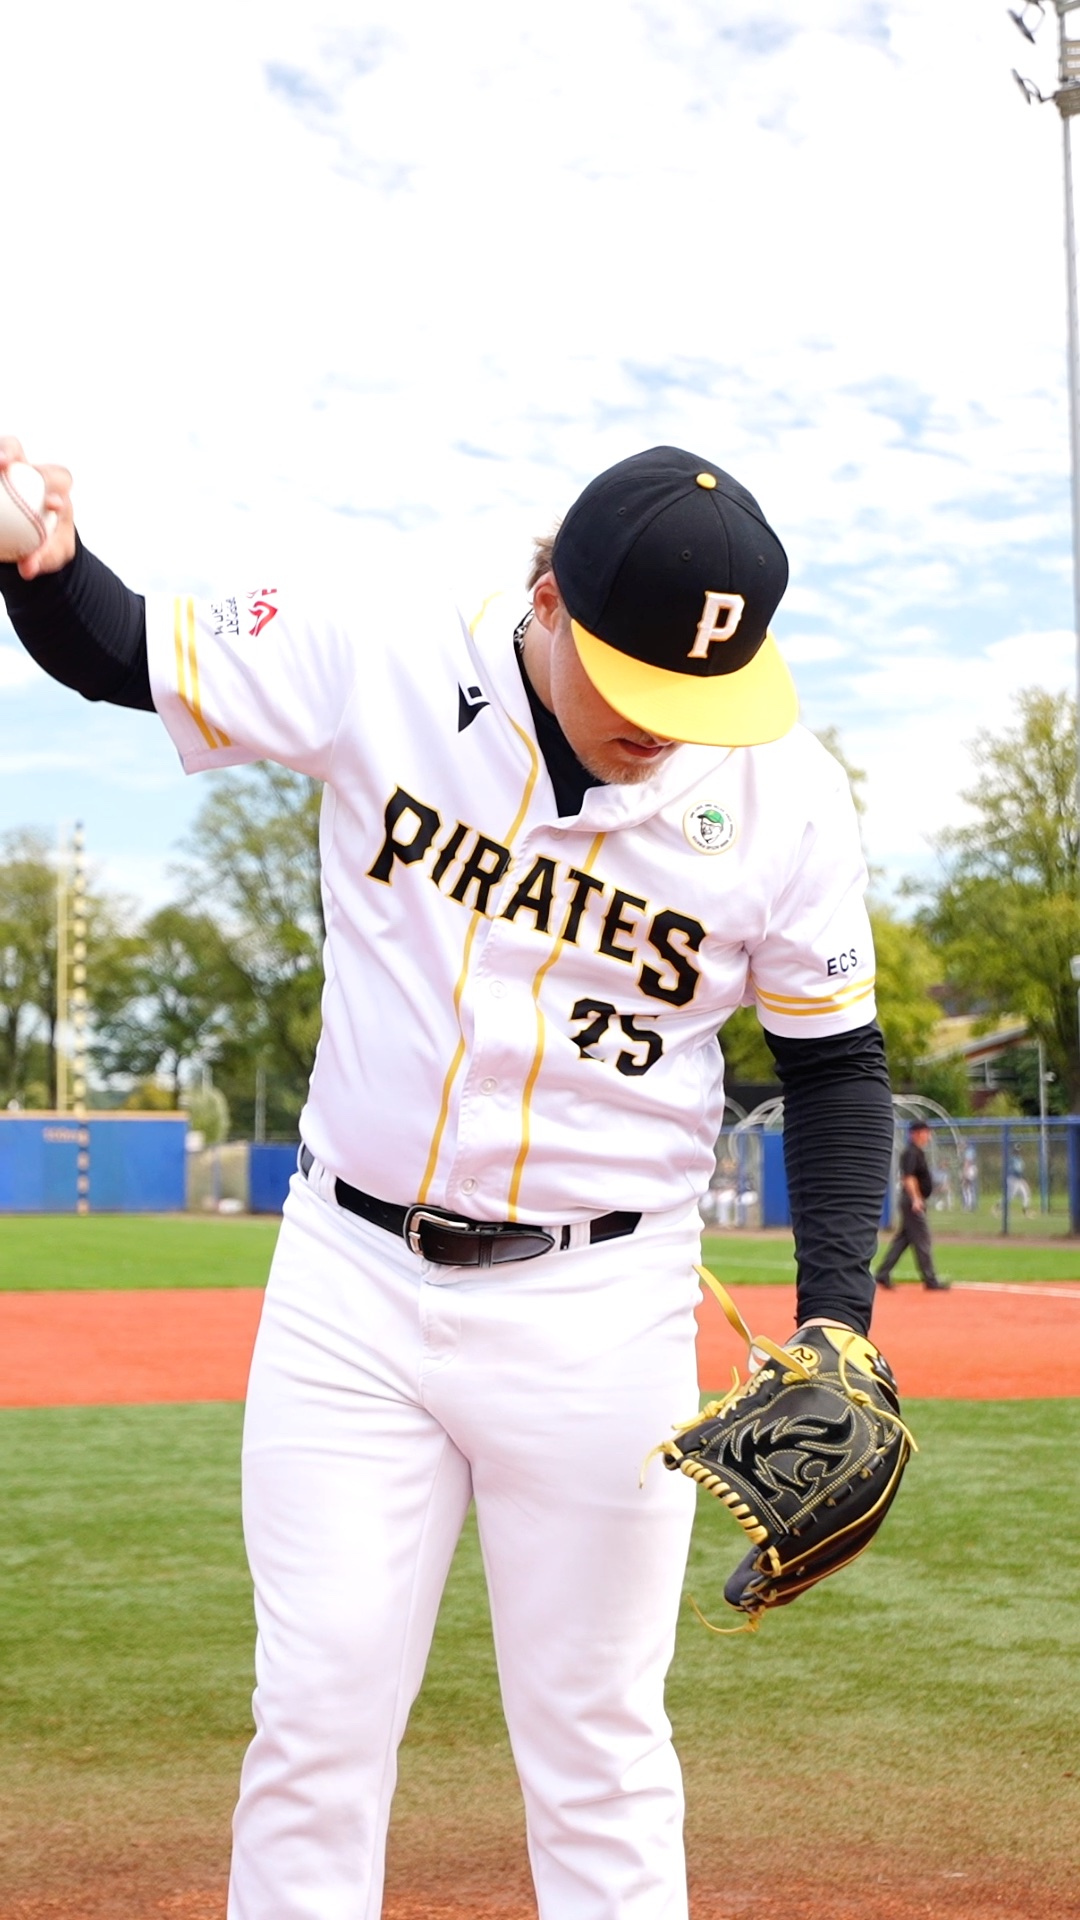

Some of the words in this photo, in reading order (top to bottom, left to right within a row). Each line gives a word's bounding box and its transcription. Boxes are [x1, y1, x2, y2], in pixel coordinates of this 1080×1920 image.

[687, 590, 745, 659] P
[365, 783, 707, 1009] PIRATES
[827, 948, 858, 977] ECS
[568, 997, 664, 1077] 25
